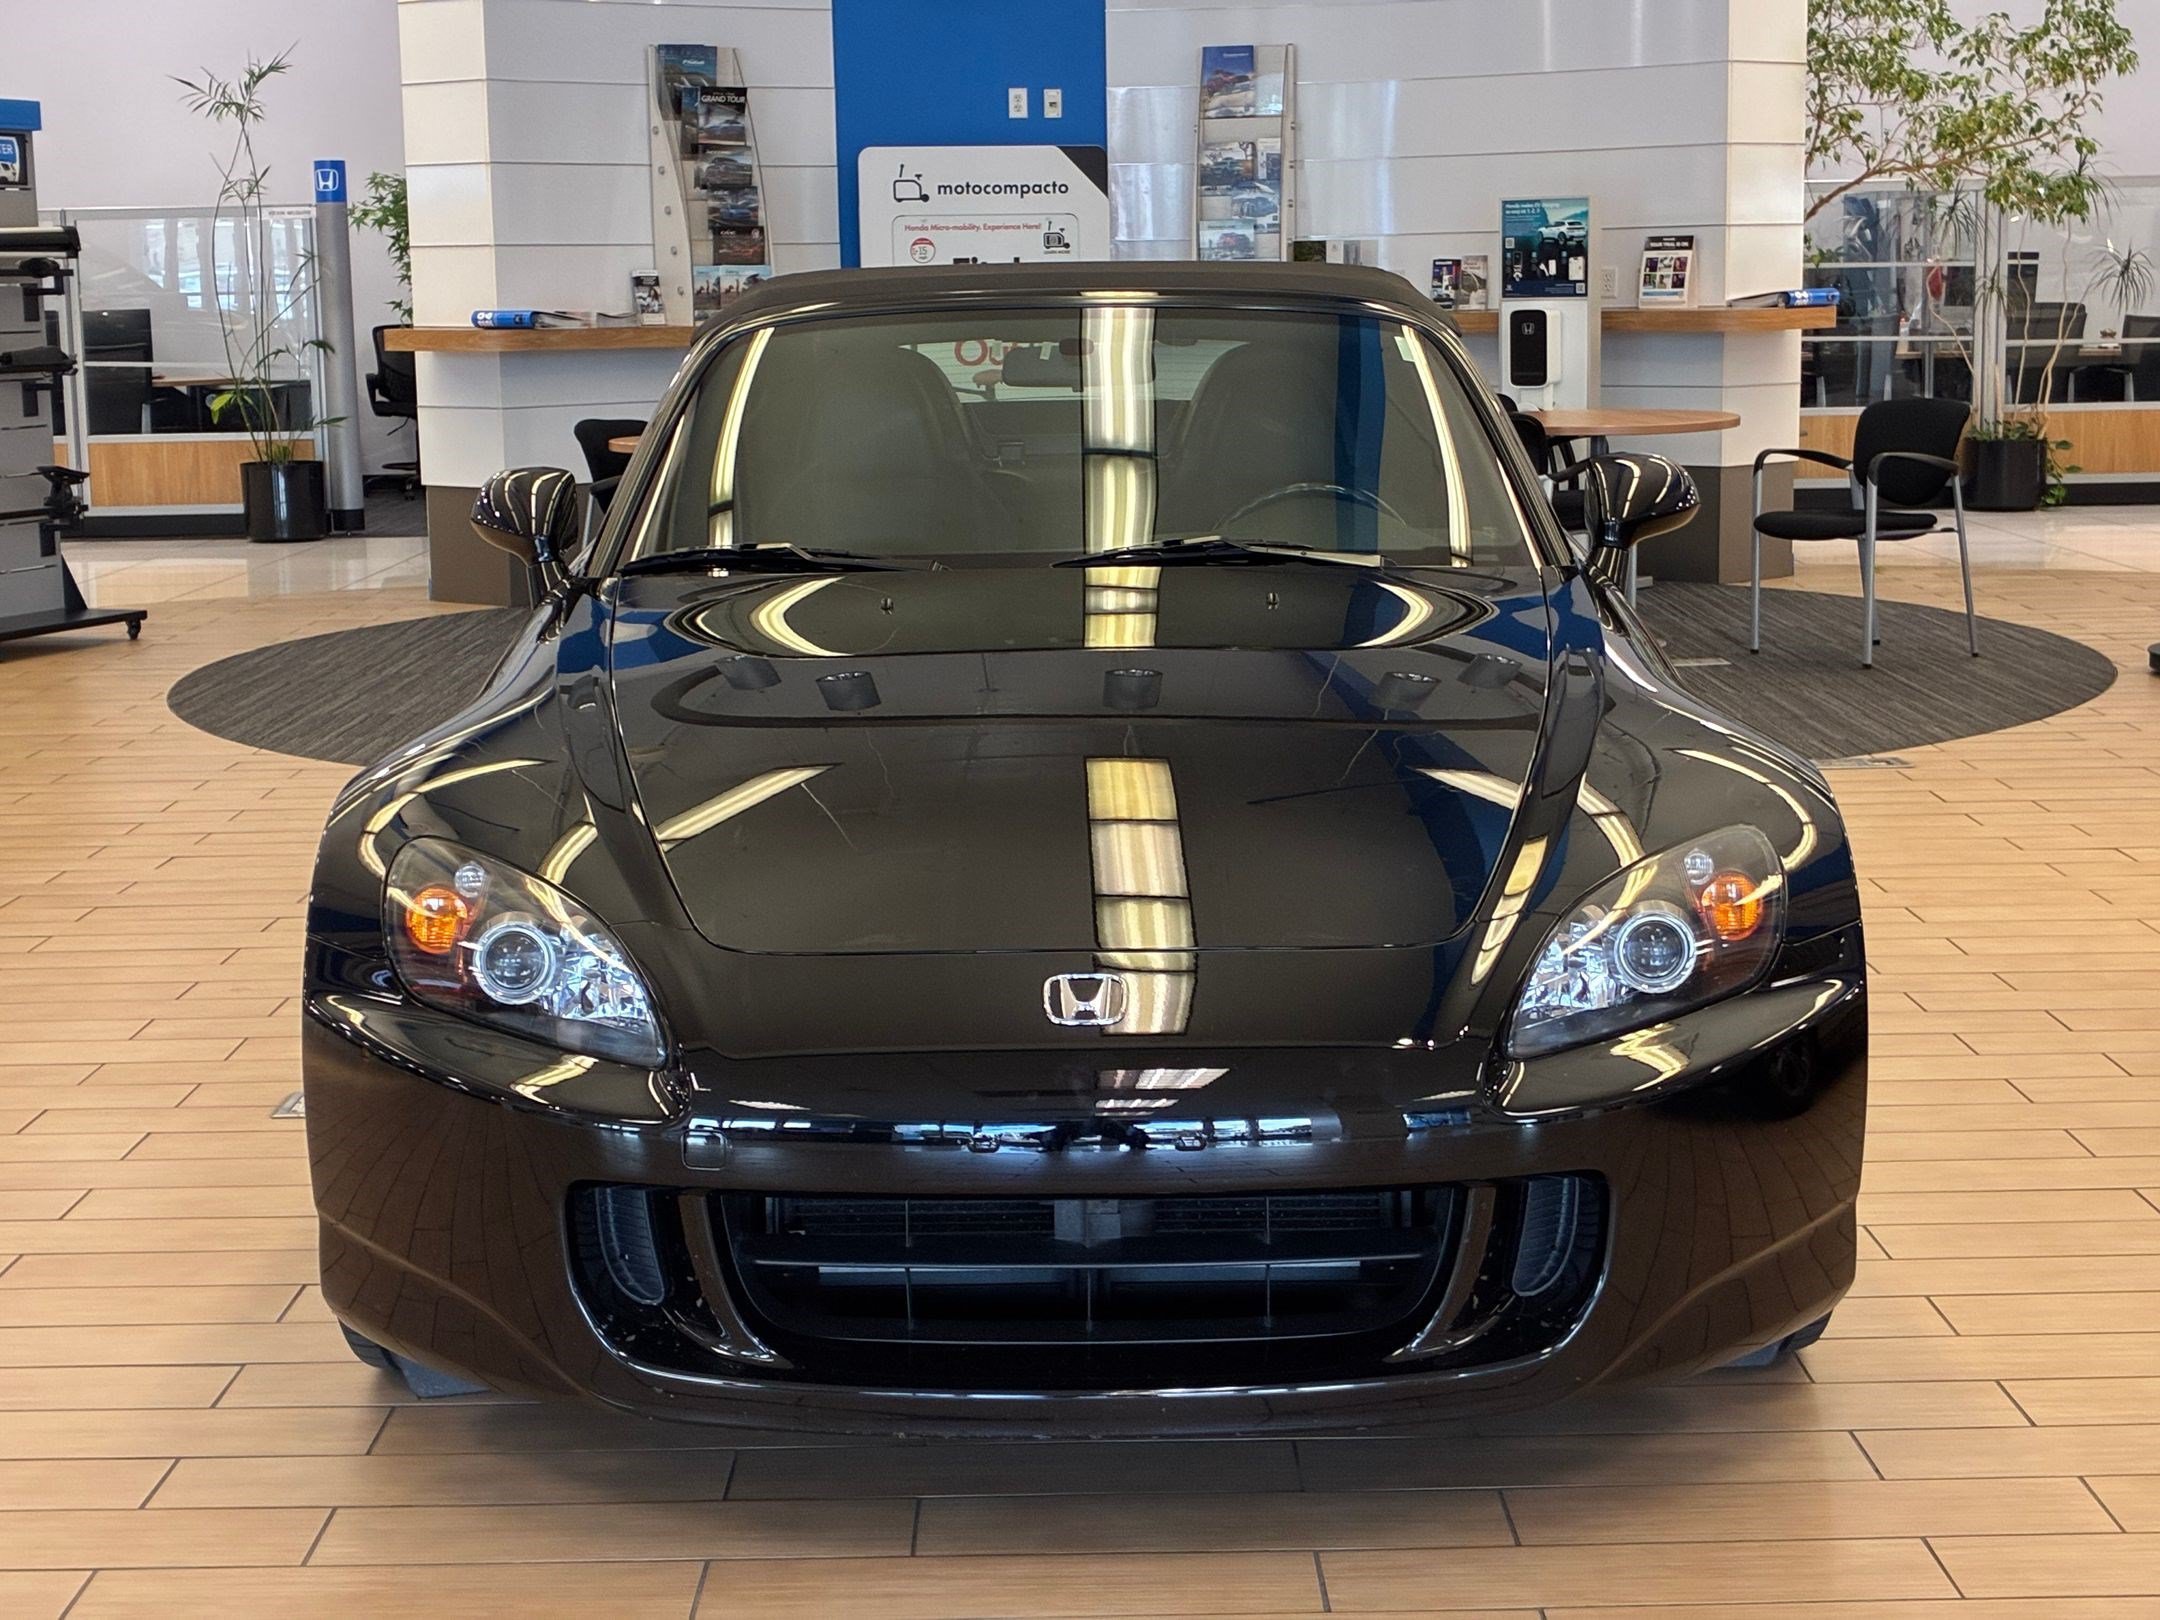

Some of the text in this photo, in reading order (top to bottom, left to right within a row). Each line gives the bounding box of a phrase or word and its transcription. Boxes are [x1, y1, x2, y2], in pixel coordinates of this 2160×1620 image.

[701, 95, 726, 103] GRAND
[937, 181, 1069, 199] motocompacto
[904, 224, 929, 232] Honda
[983, 223, 1021, 232] Experience
